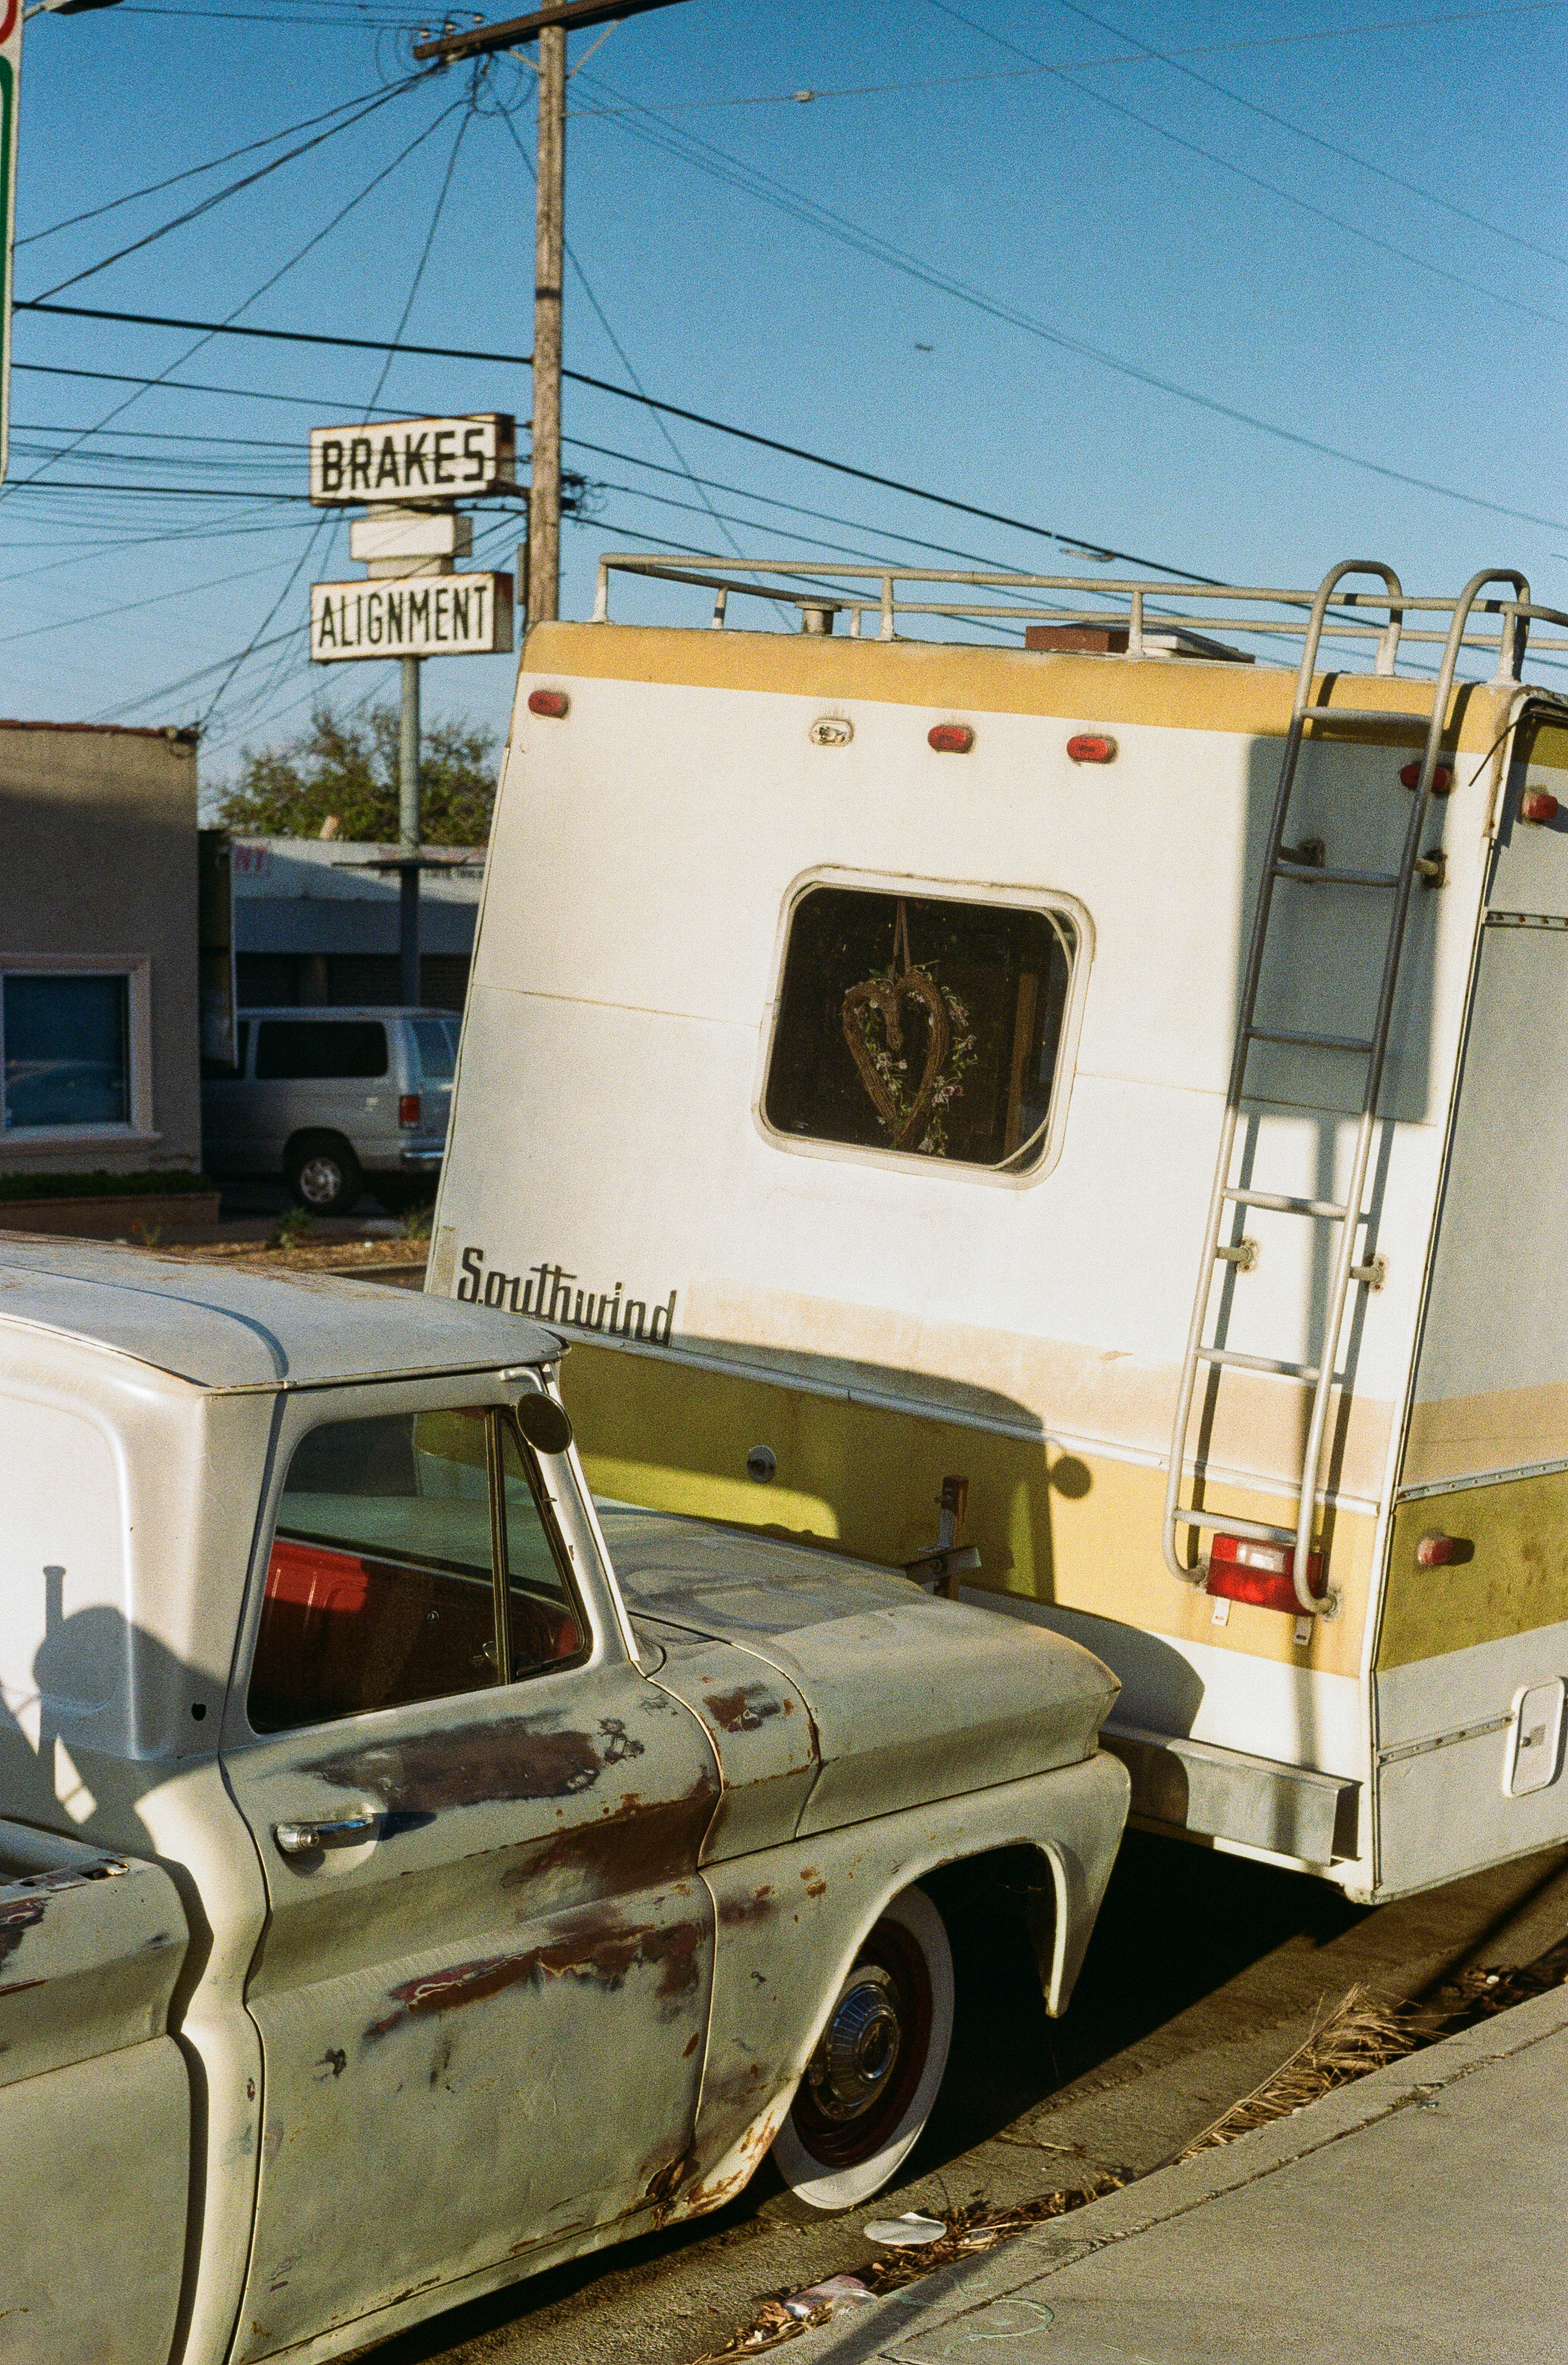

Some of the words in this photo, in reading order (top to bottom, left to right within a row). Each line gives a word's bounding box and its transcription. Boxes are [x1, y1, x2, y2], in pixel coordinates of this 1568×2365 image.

[321, 428, 485, 492] BRAKES
[318, 586, 487, 648] ALIGNMENT
[457, 1247, 677, 1347] Southwind
